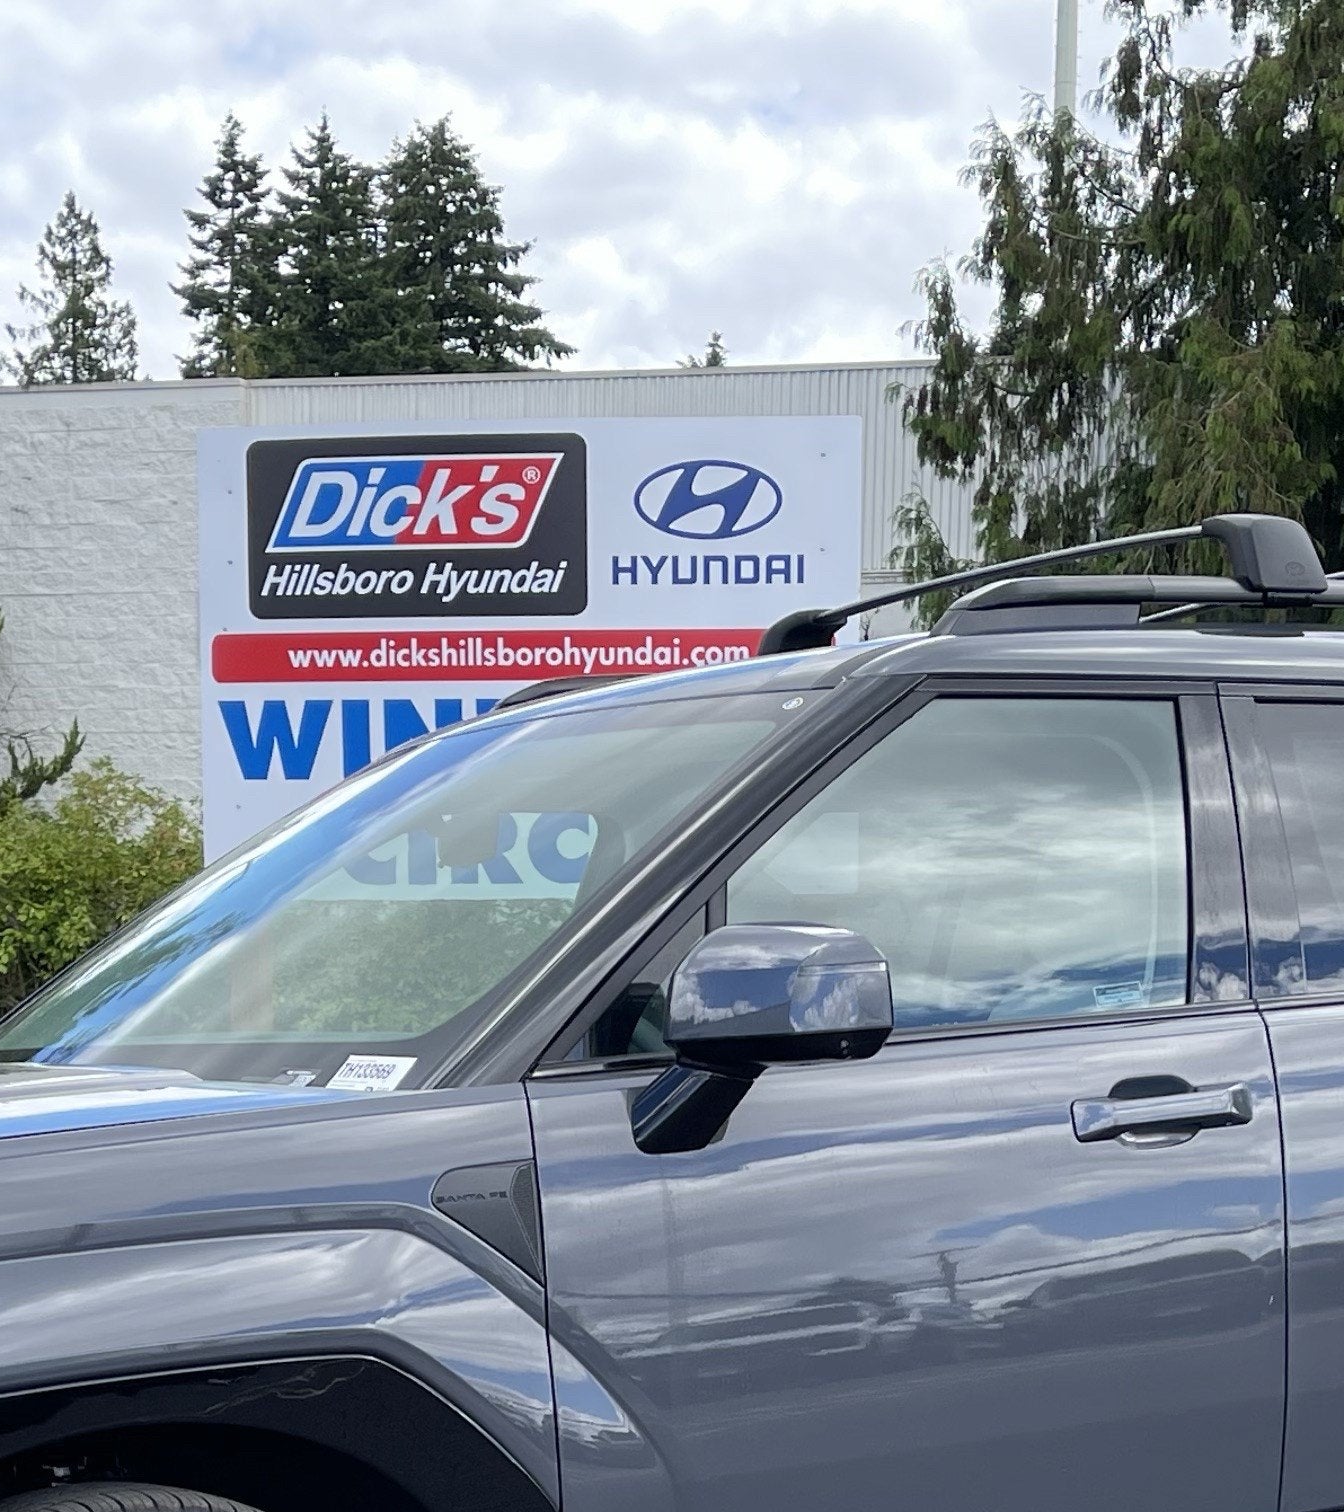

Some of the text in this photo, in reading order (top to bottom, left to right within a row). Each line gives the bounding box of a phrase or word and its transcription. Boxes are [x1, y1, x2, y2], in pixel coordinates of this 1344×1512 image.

[289, 465, 526, 538] Dick's
[260, 560, 567, 603] Hillsboro Hyundai
[611, 554, 805, 586] HYUNDAI
[288, 637, 749, 675] www.dickshillsborohyundai.com
[218, 699, 503, 780] WIN
